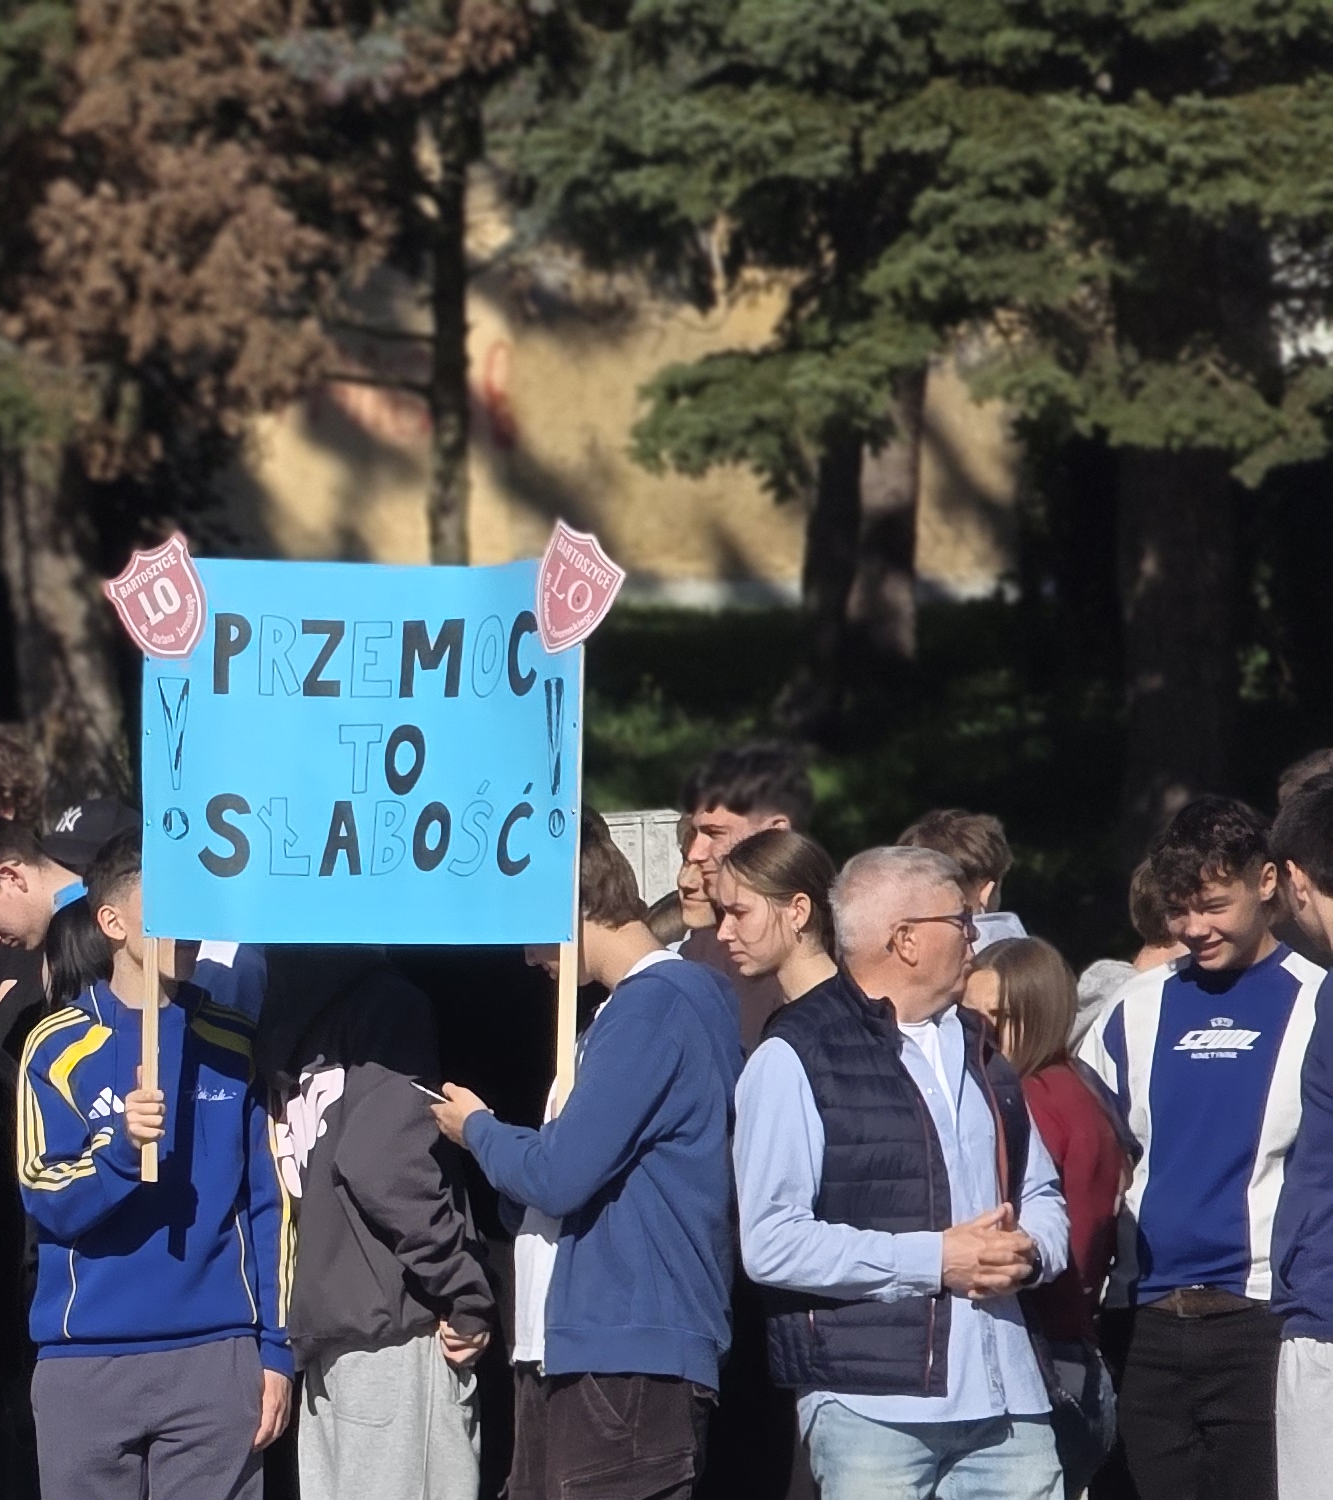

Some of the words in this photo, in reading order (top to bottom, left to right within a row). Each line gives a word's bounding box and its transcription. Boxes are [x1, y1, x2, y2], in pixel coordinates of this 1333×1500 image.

[119, 552, 177, 598] BARTOSZYCE
[551, 562, 592, 613] LO
[556, 535, 612, 590] BARTOSZYCE
[138, 577, 181, 626] LO
[213, 610, 538, 698] PRZEMOC
[339, 723, 425, 795] TO
[198, 780, 534, 877] SŁABOŚĆ
